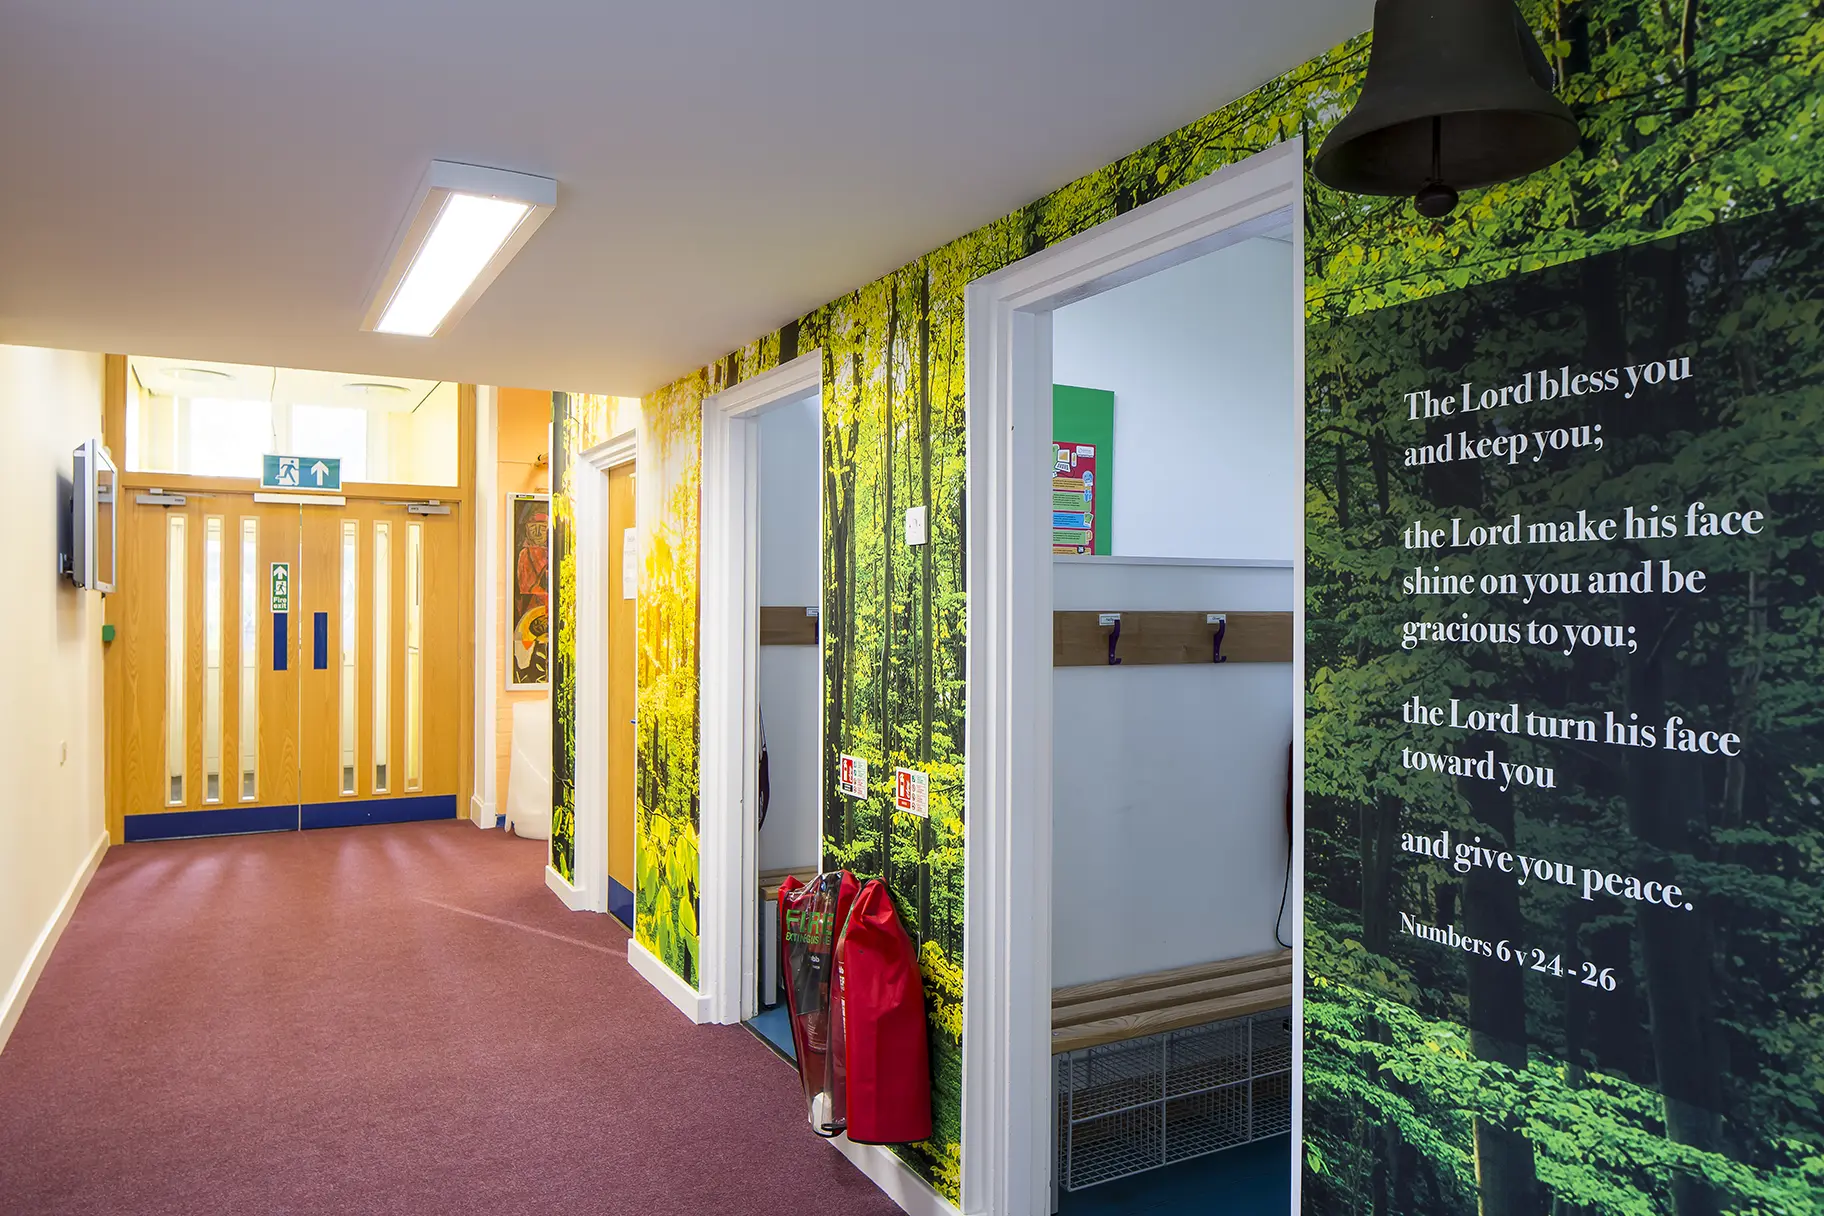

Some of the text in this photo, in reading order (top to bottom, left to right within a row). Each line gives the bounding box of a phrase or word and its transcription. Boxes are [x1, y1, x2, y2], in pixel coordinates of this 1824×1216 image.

[1403, 356, 1693, 421] The Lord bless you
[1403, 423, 1604, 467] and keep you;
[1403, 500, 1765, 550] the Lord make his face
[1402, 559, 1707, 605] shine on you and be
[1401, 612, 1638, 656] gracious to you;
[1402, 695, 1742, 757] the Lord turn his face
[1401, 745, 1557, 793] toward you
[1401, 830, 1694, 912] and give you peace.
[786, 909, 835, 935] FIRE
[1399, 911, 1493, 959] Numbers
[1496, 939, 1511, 963] 6
[1514, 949, 1528, 967] v
[1531, 948, 1564, 979] 24
[1581, 961, 1617, 992] 26
